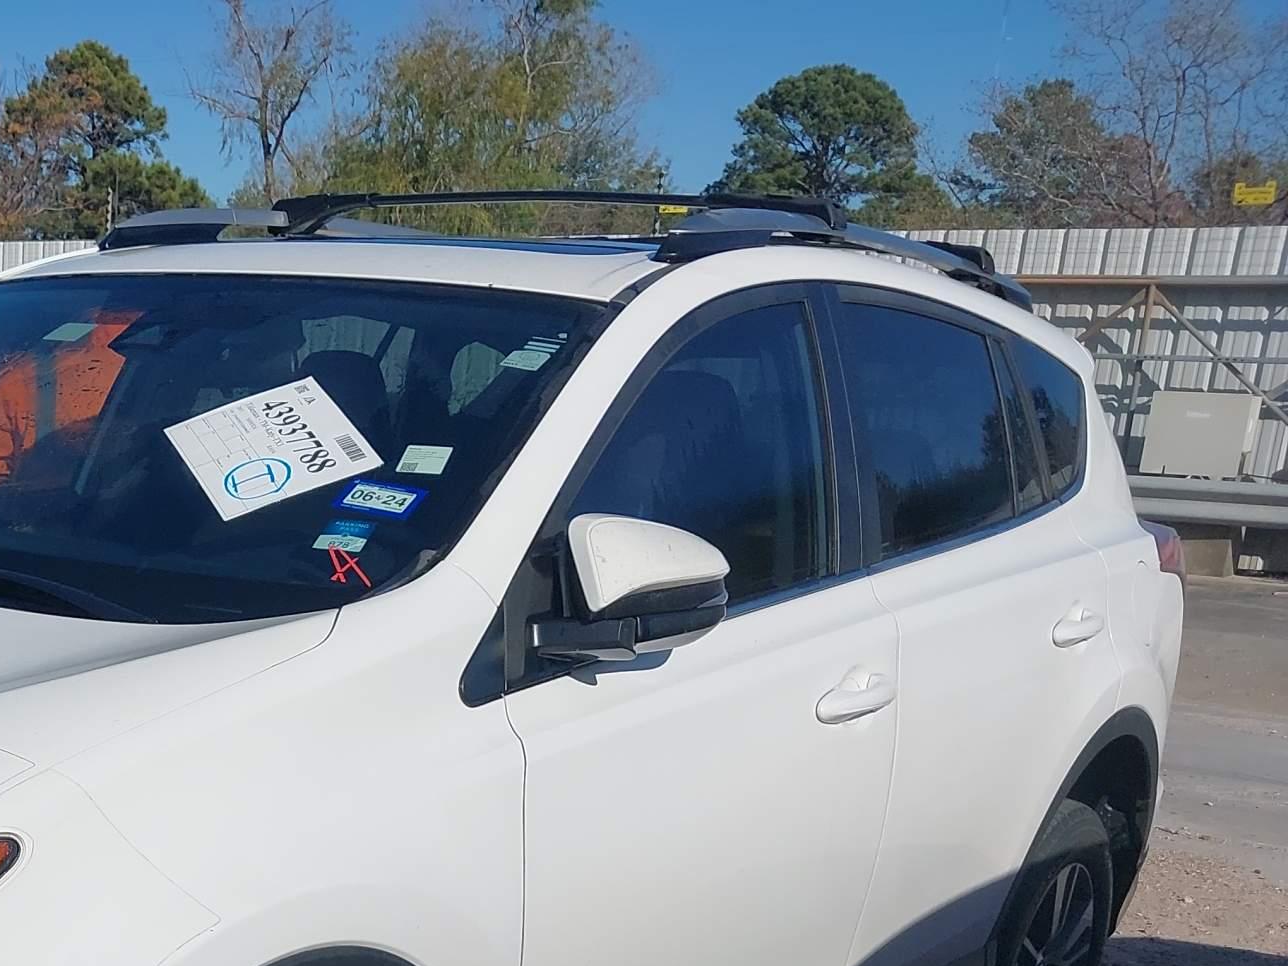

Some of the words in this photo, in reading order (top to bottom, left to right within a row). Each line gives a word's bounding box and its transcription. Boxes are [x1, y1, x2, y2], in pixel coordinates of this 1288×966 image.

[262, 399, 337, 474] 43937788
[350, 489, 377, 502] 06
[381, 494, 409, 508] 24
